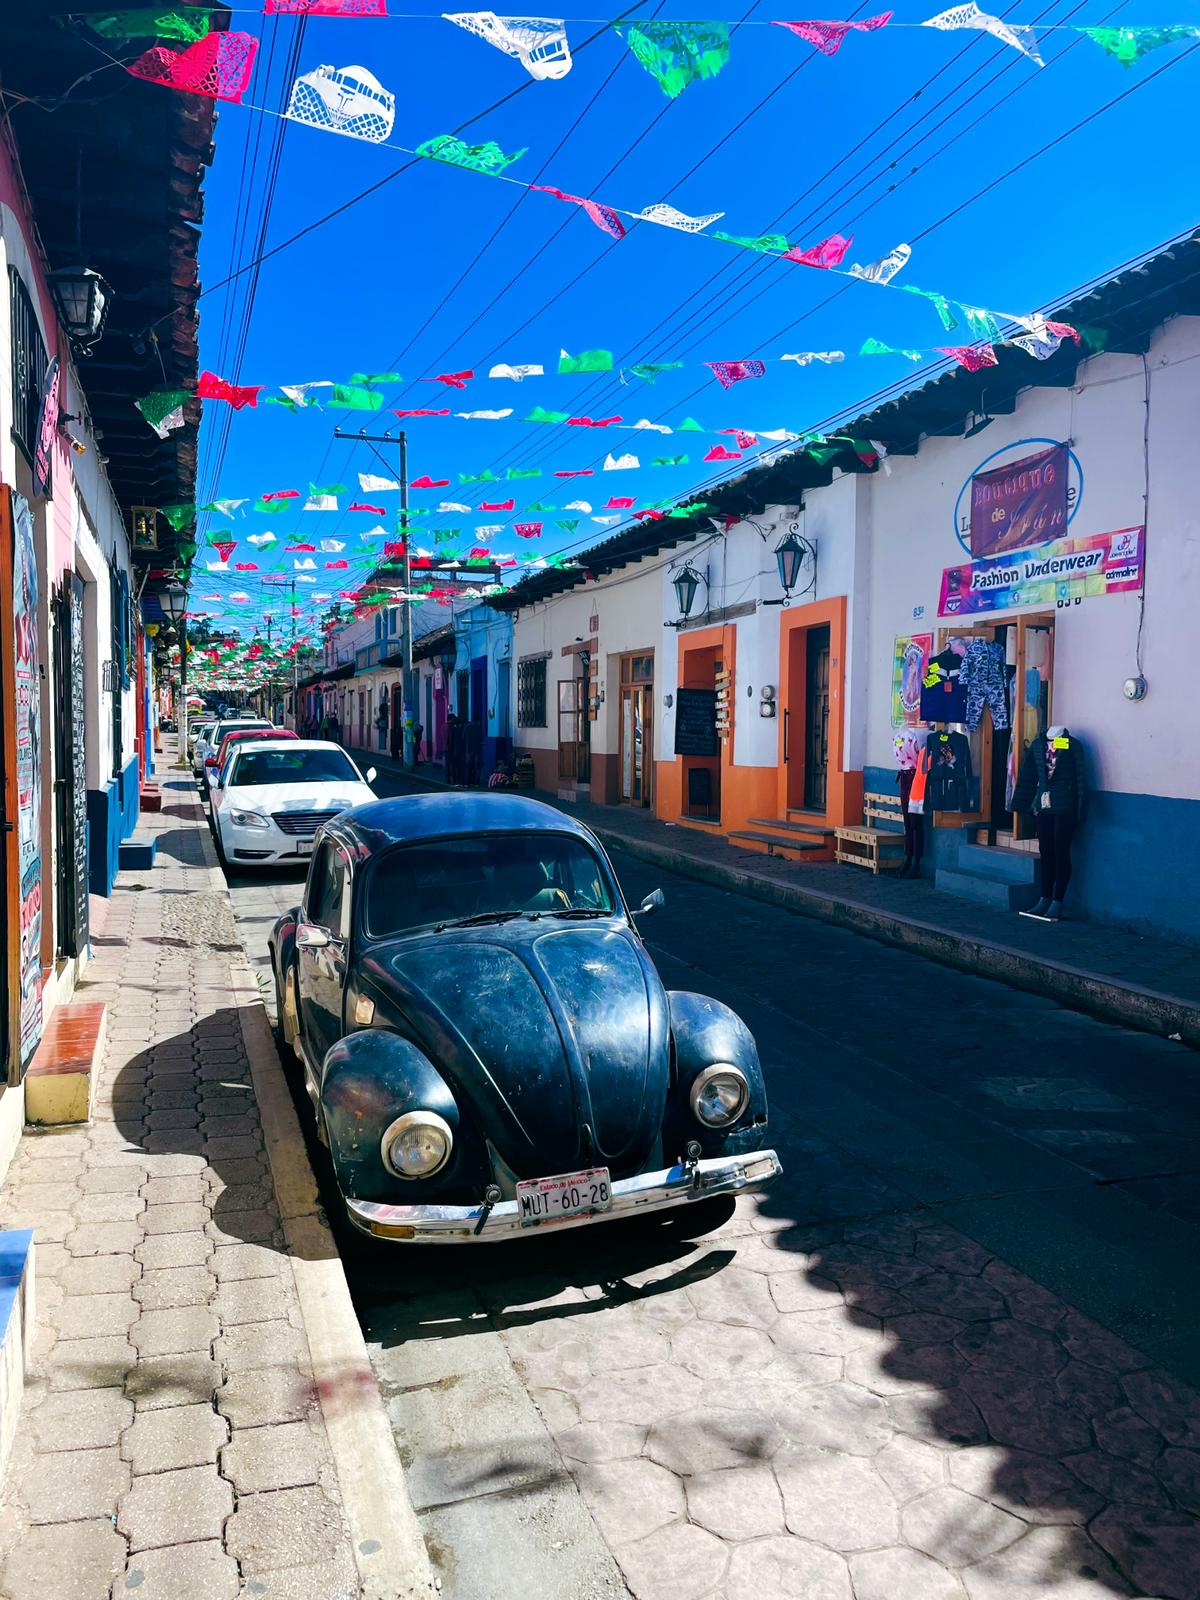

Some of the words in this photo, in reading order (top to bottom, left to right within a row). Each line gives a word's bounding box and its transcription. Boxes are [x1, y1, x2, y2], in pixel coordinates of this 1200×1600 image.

[991, 507, 1006, 523] de
[971, 569, 1019, 589] Fashion
[1024, 553, 1102, 579] Underwear
[521, 1182, 609, 1218] MUT-60-28
